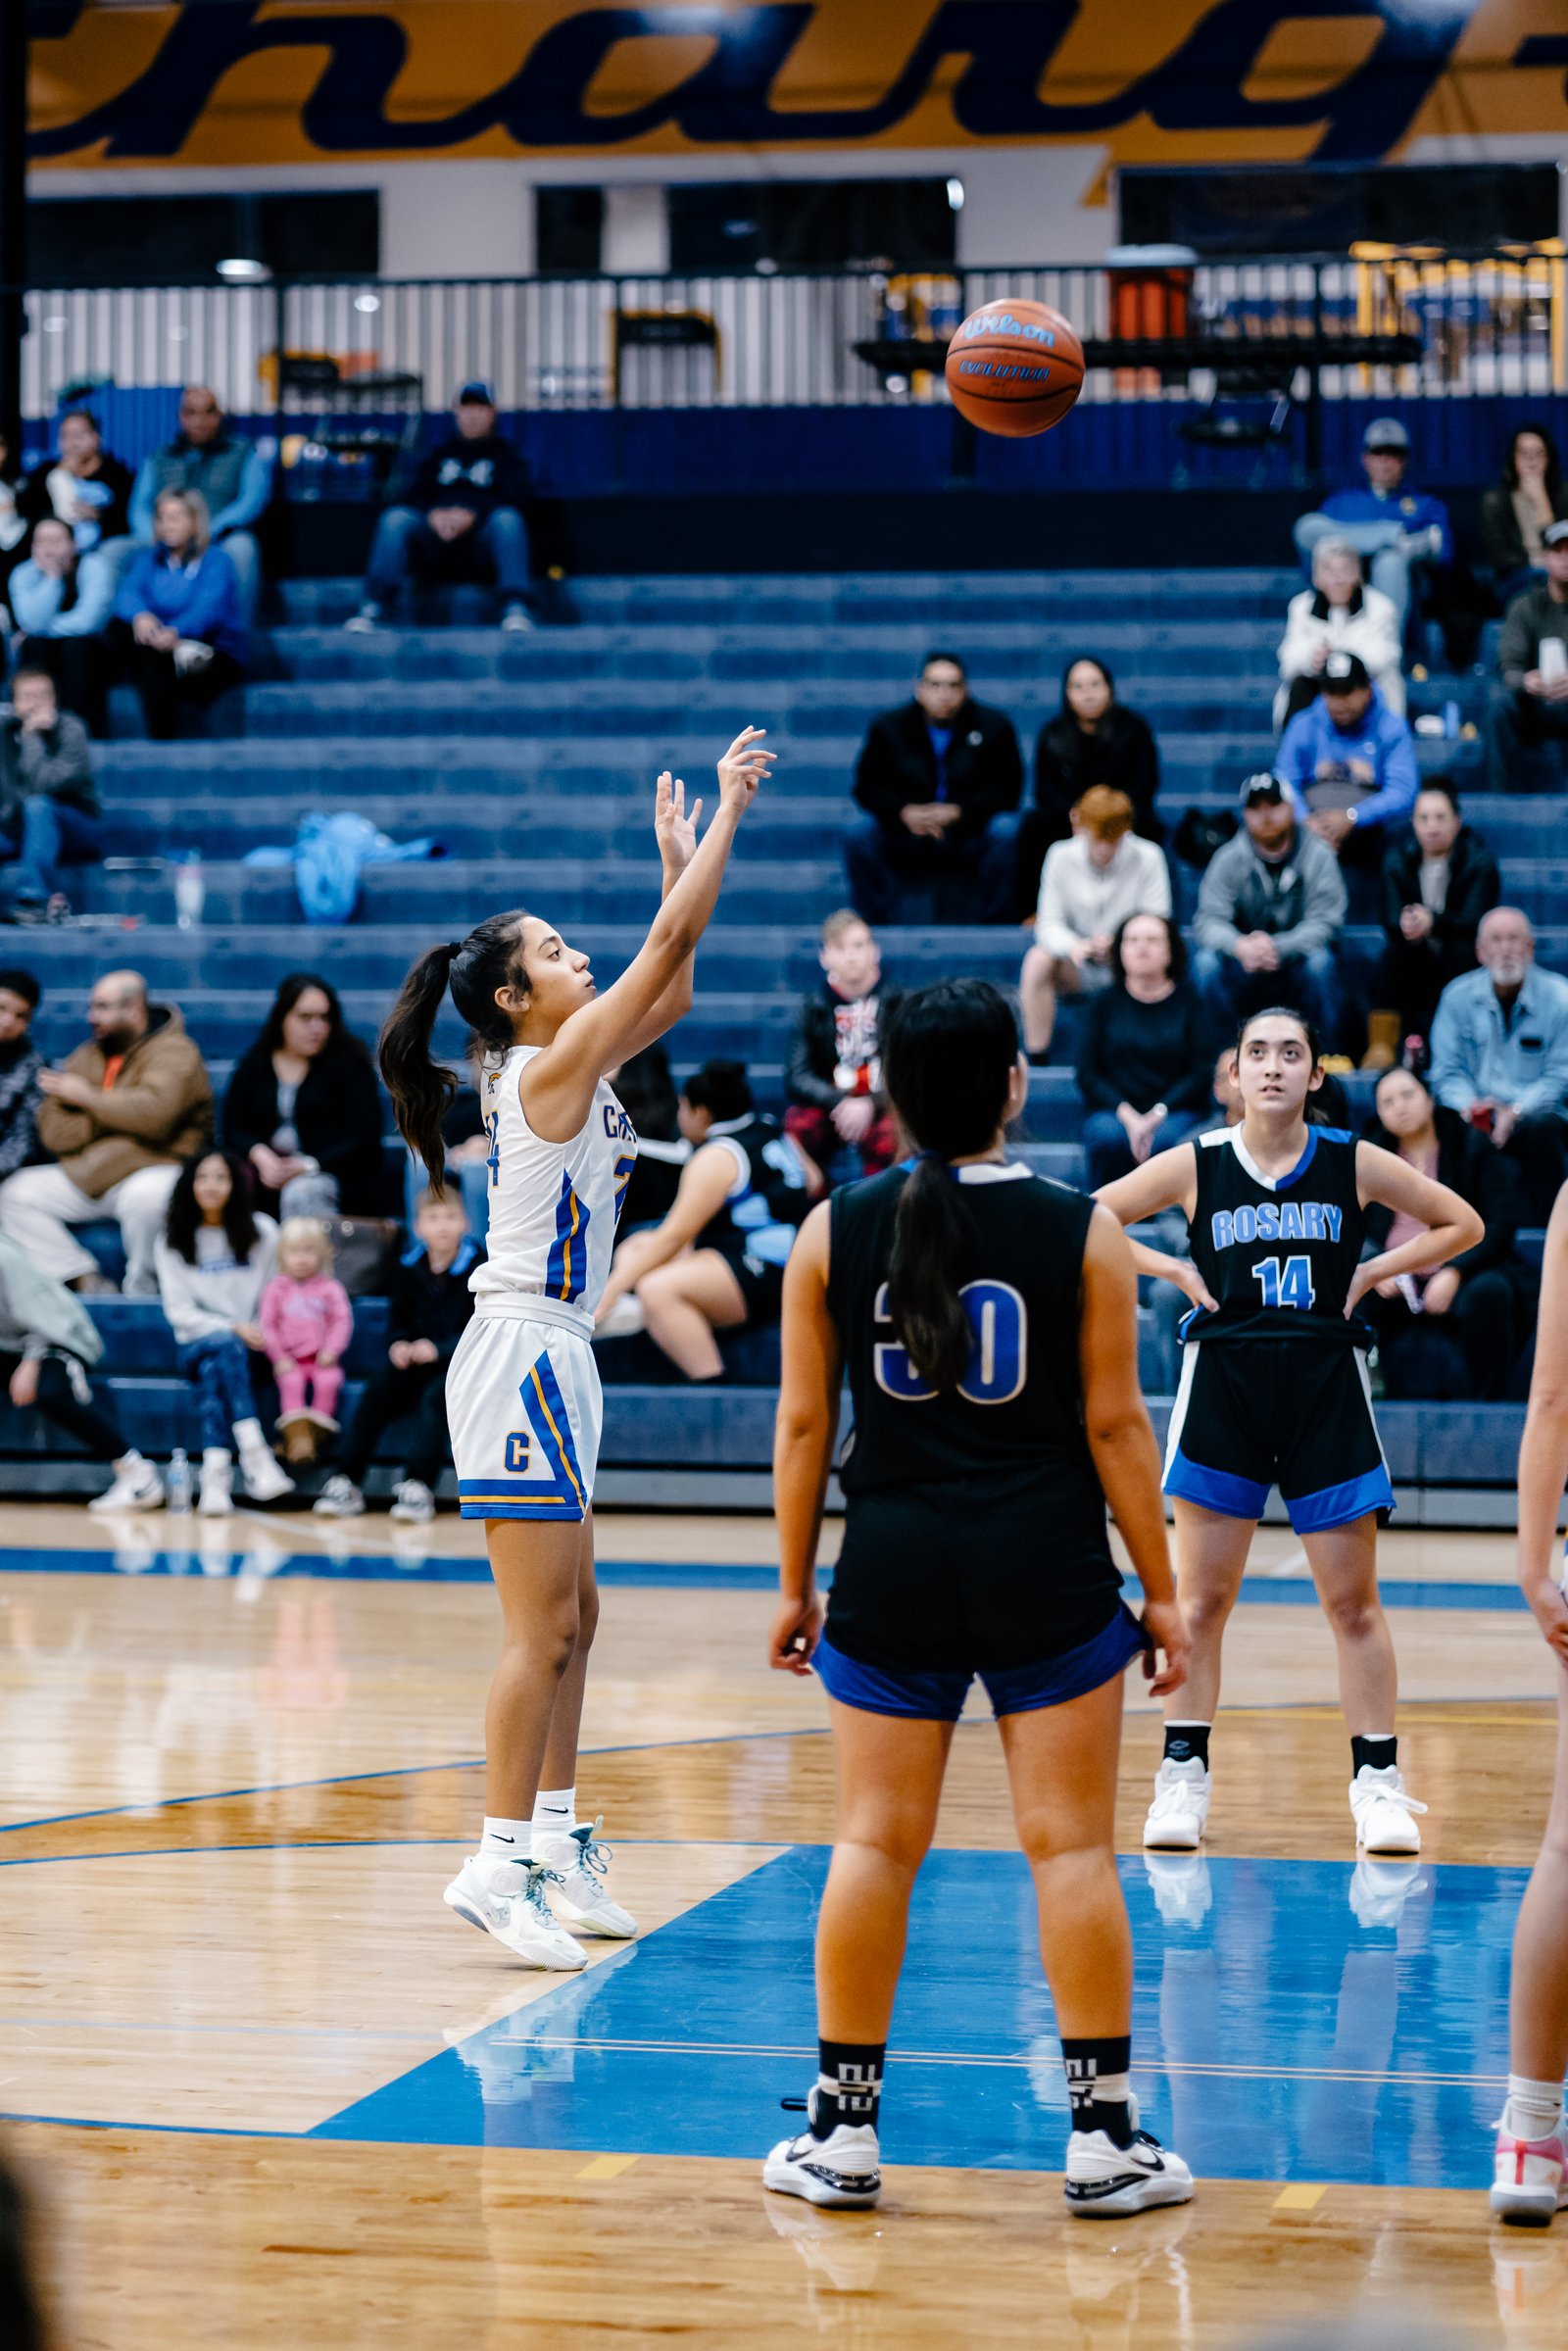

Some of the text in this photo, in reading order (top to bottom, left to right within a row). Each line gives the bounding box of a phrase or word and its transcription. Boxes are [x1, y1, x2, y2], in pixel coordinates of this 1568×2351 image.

[26, 0, 1568, 163] harg
[963, 314, 1054, 348] Wilson
[959, 360, 1051, 382] EVOLUTION
[1211, 1201, 1343, 1251] ROSARY
[1251, 1255, 1316, 1310] 14
[504, 1430, 532, 1474] C
